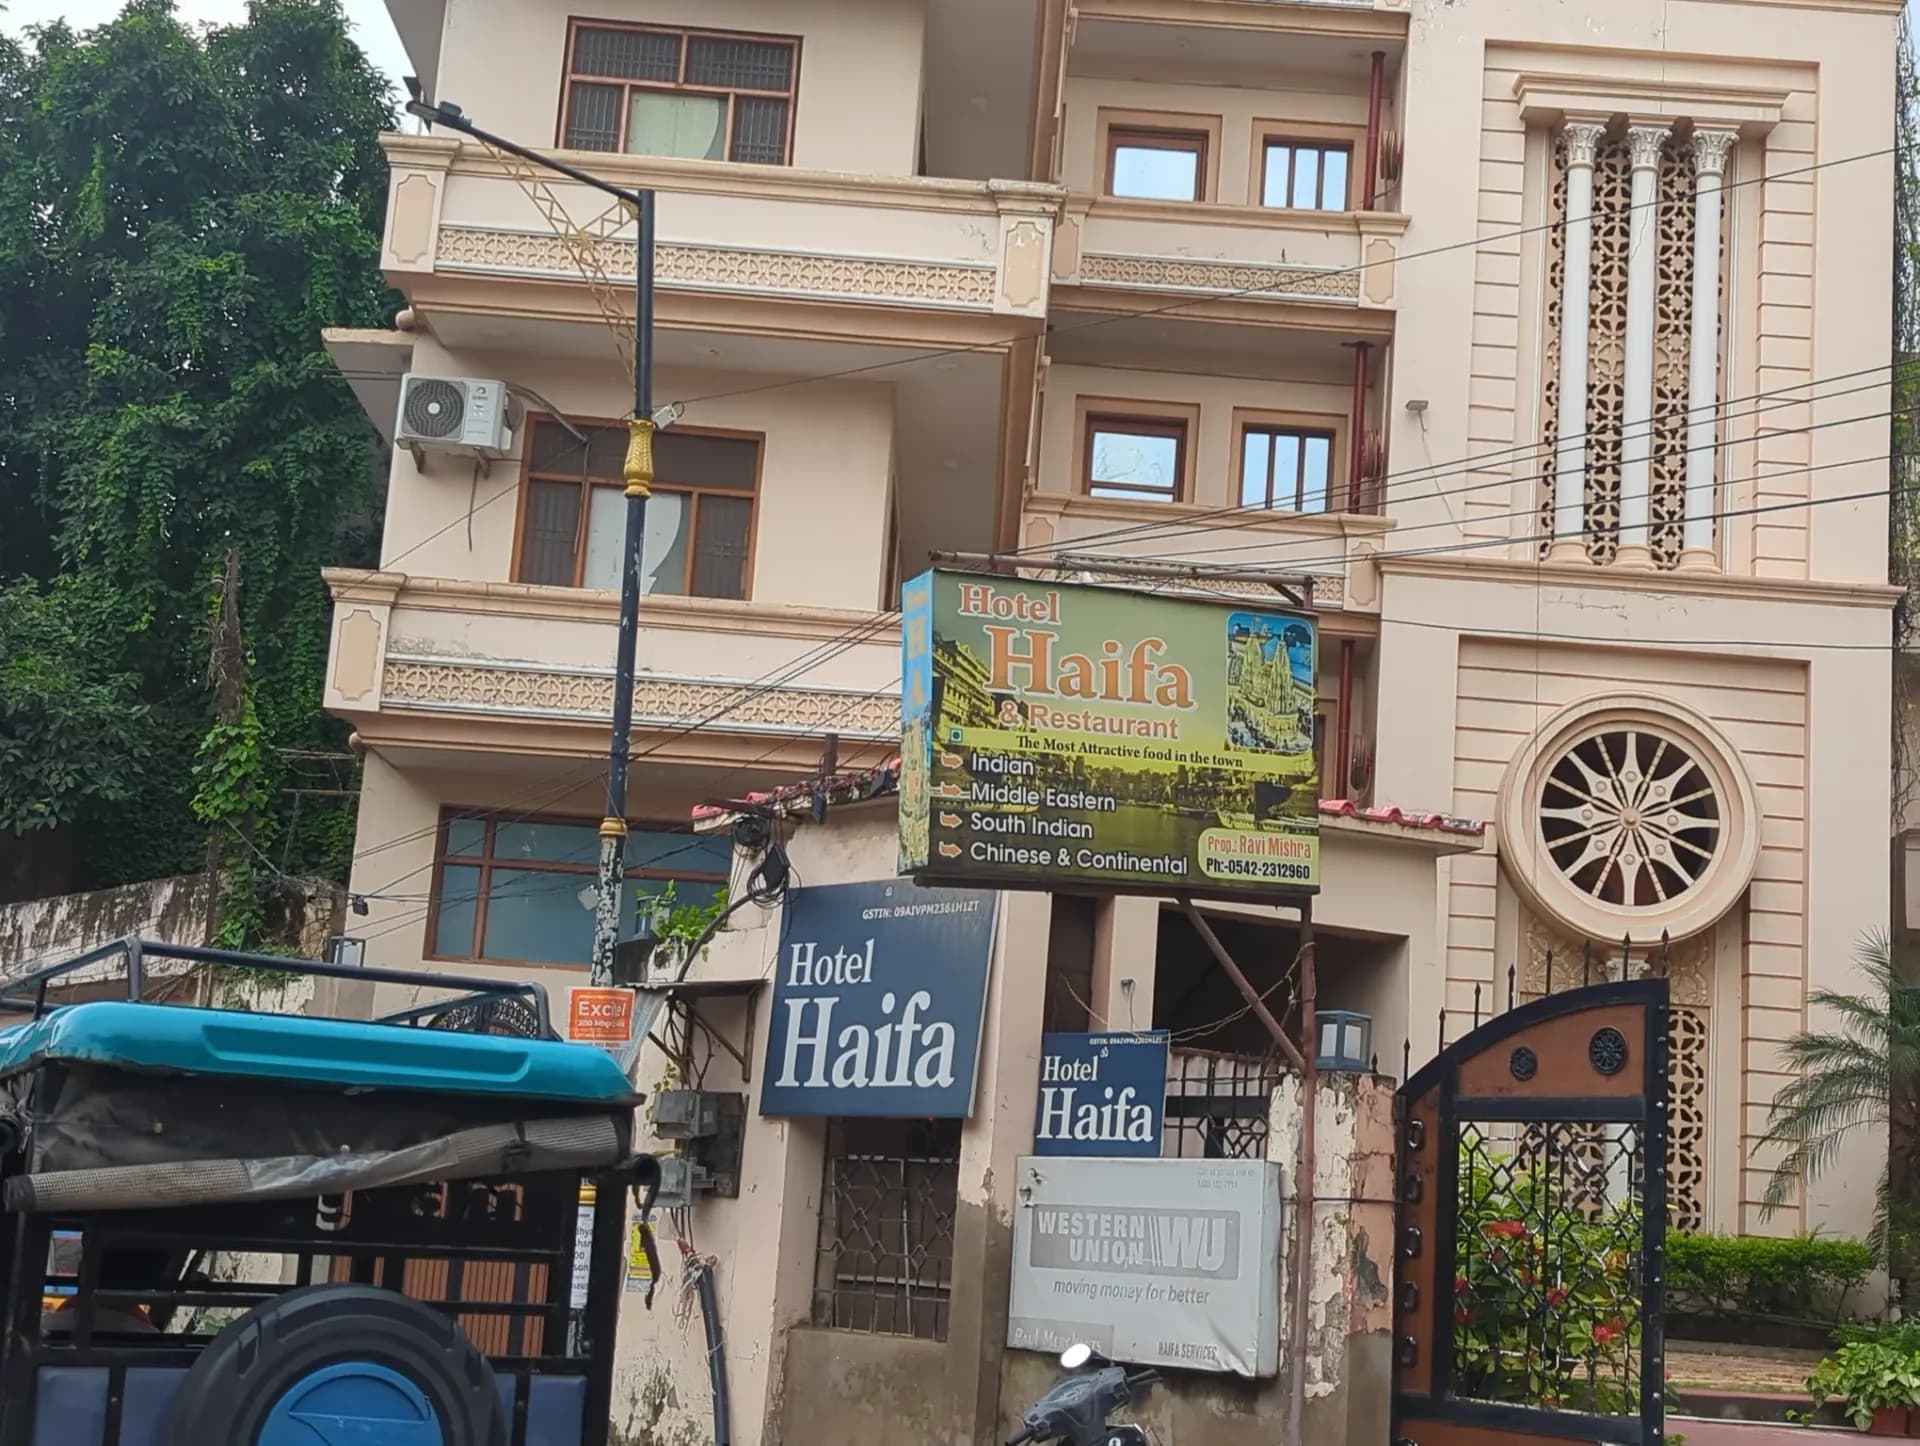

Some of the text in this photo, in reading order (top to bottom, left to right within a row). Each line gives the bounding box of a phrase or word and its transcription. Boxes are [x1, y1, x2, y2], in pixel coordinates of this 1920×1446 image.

[959, 583, 1061, 624] Hotel
[984, 625, 1197, 709] Haifa
[1000, 700, 1180, 740] & Restaurant
[971, 752, 1034, 776] Indian
[1016, 736, 1243, 767] The Most Attractive food in the town
[971, 782, 1116, 811] Middle Eastern
[971, 812, 1092, 838] South Indian
[970, 842, 1187, 875] Chinese & Continental
[1239, 835, 1265, 854] Ravi
[1268, 837, 1311, 858] Mishra
[1206, 857, 1310, 879] Ph:-0542-2312960
[862, 908, 892, 920] GSTIN:
[786, 938, 875, 986] Hotel
[775, 990, 956, 1089] Haifa
[1042, 1055, 1098, 1081] Hotel
[1036, 1086, 1153, 1142] Haifa
[1038, 1211, 1227, 1272] WESTERN WU
[1070, 1238, 1144, 1265] UNION
[1054, 1278, 1210, 1304] moving money for better
[1158, 1341, 1217, 1360] HAIFA SERVICES
